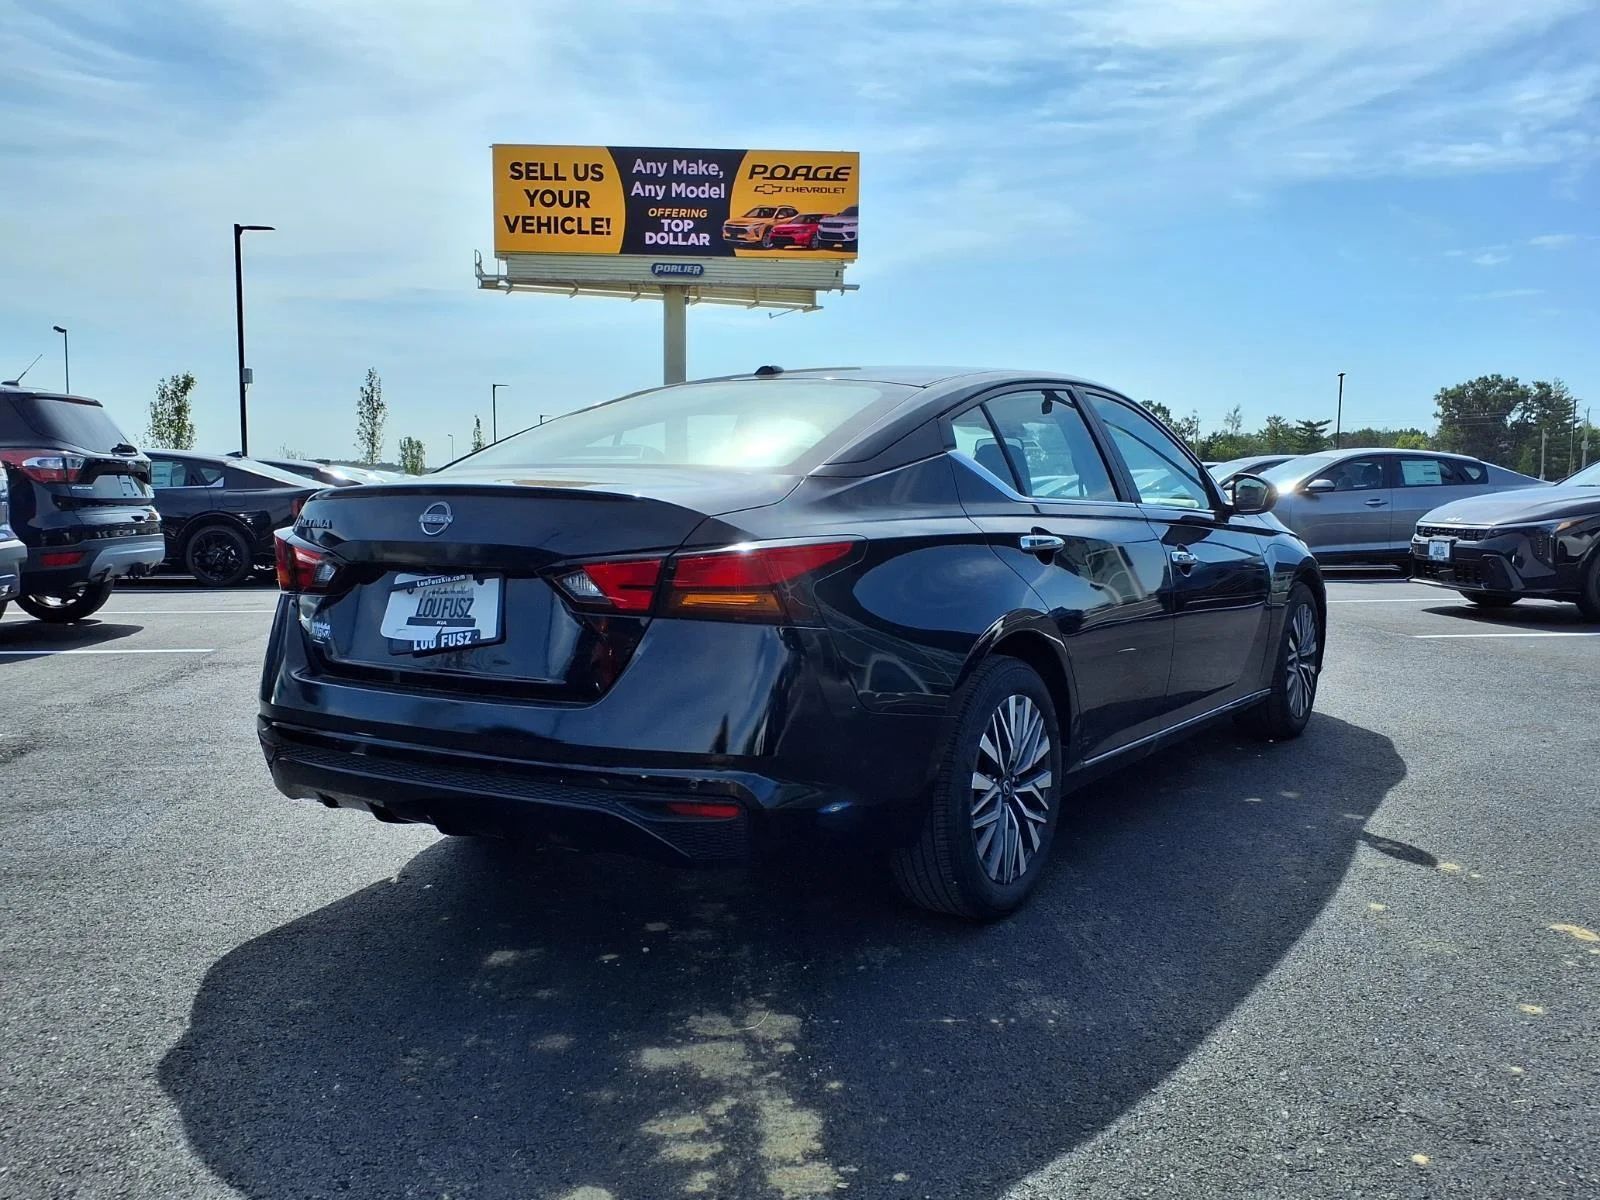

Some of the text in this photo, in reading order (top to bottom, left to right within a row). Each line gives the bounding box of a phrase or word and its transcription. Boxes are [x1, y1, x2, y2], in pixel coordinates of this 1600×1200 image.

[509, 161, 604, 182] SELL US
[632, 158, 724, 178] Any Make,
[748, 164, 852, 181] POAGE
[524, 188, 591, 208] YOUR
[630, 181, 725, 200] Any Model
[785, 186, 846, 194] CHEVROLET
[648, 207, 708, 218] OFFERING
[503, 215, 612, 236] VEHICLE!
[661, 219, 694, 232] TOP
[645, 232, 711, 246] DOLLAR
[654, 264, 701, 275] PORLIER
[415, 598, 475, 618] LOU FUSZ
[440, 631, 473, 648] FUSZ
